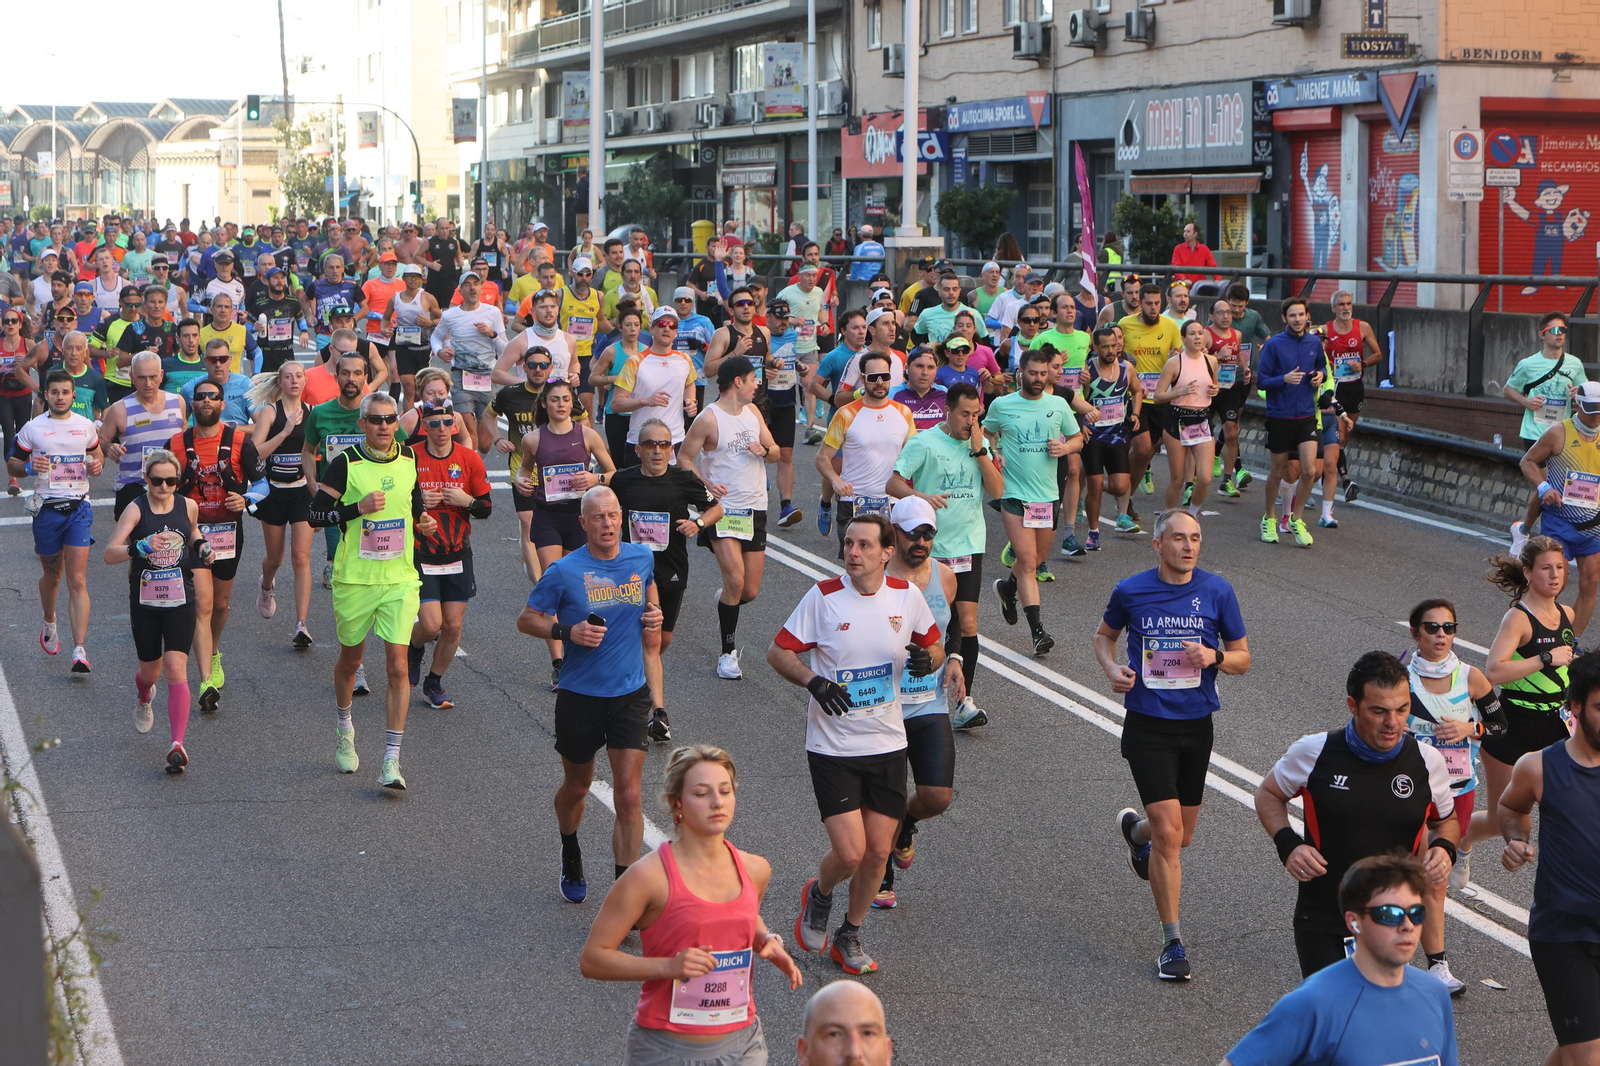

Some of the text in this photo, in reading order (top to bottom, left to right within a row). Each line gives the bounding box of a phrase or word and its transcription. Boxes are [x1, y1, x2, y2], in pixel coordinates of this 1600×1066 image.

[1350, 40, 1402, 52] HOSTAL
[1462, 48, 1542, 60] BENIDORM
[1296, 80, 1330, 101] JIMENEZ
[961, 107, 994, 125] AUTOCLIMA
[1539, 135, 1585, 154] Jiménez
[1540, 161, 1600, 172] RECAMBIOS
[735, 430, 749, 439] THE
[727, 438, 750, 448] NORTH
[1579, 474, 1599, 482] ZURICH
[420, 481, 465, 489] ORREDORES
[377, 521, 401, 529] ZURICH
[154, 571, 177, 579] ZURICH
[587, 586, 613, 603] HOOD
[619, 580, 643, 598] COAST
[1141, 614, 1204, 629] LA ARMUÑA
[1162, 641, 1188, 649] ZURI
[856, 668, 887, 679] ZURICH
[858, 687, 877, 697] 6449
[908, 685, 929, 693] CABEZA
[873, 696, 886, 705] PRO
[716, 955, 743, 968] URICH
[704, 982, 728, 993] 8288
[698, 997, 731, 1008] JEANNE
